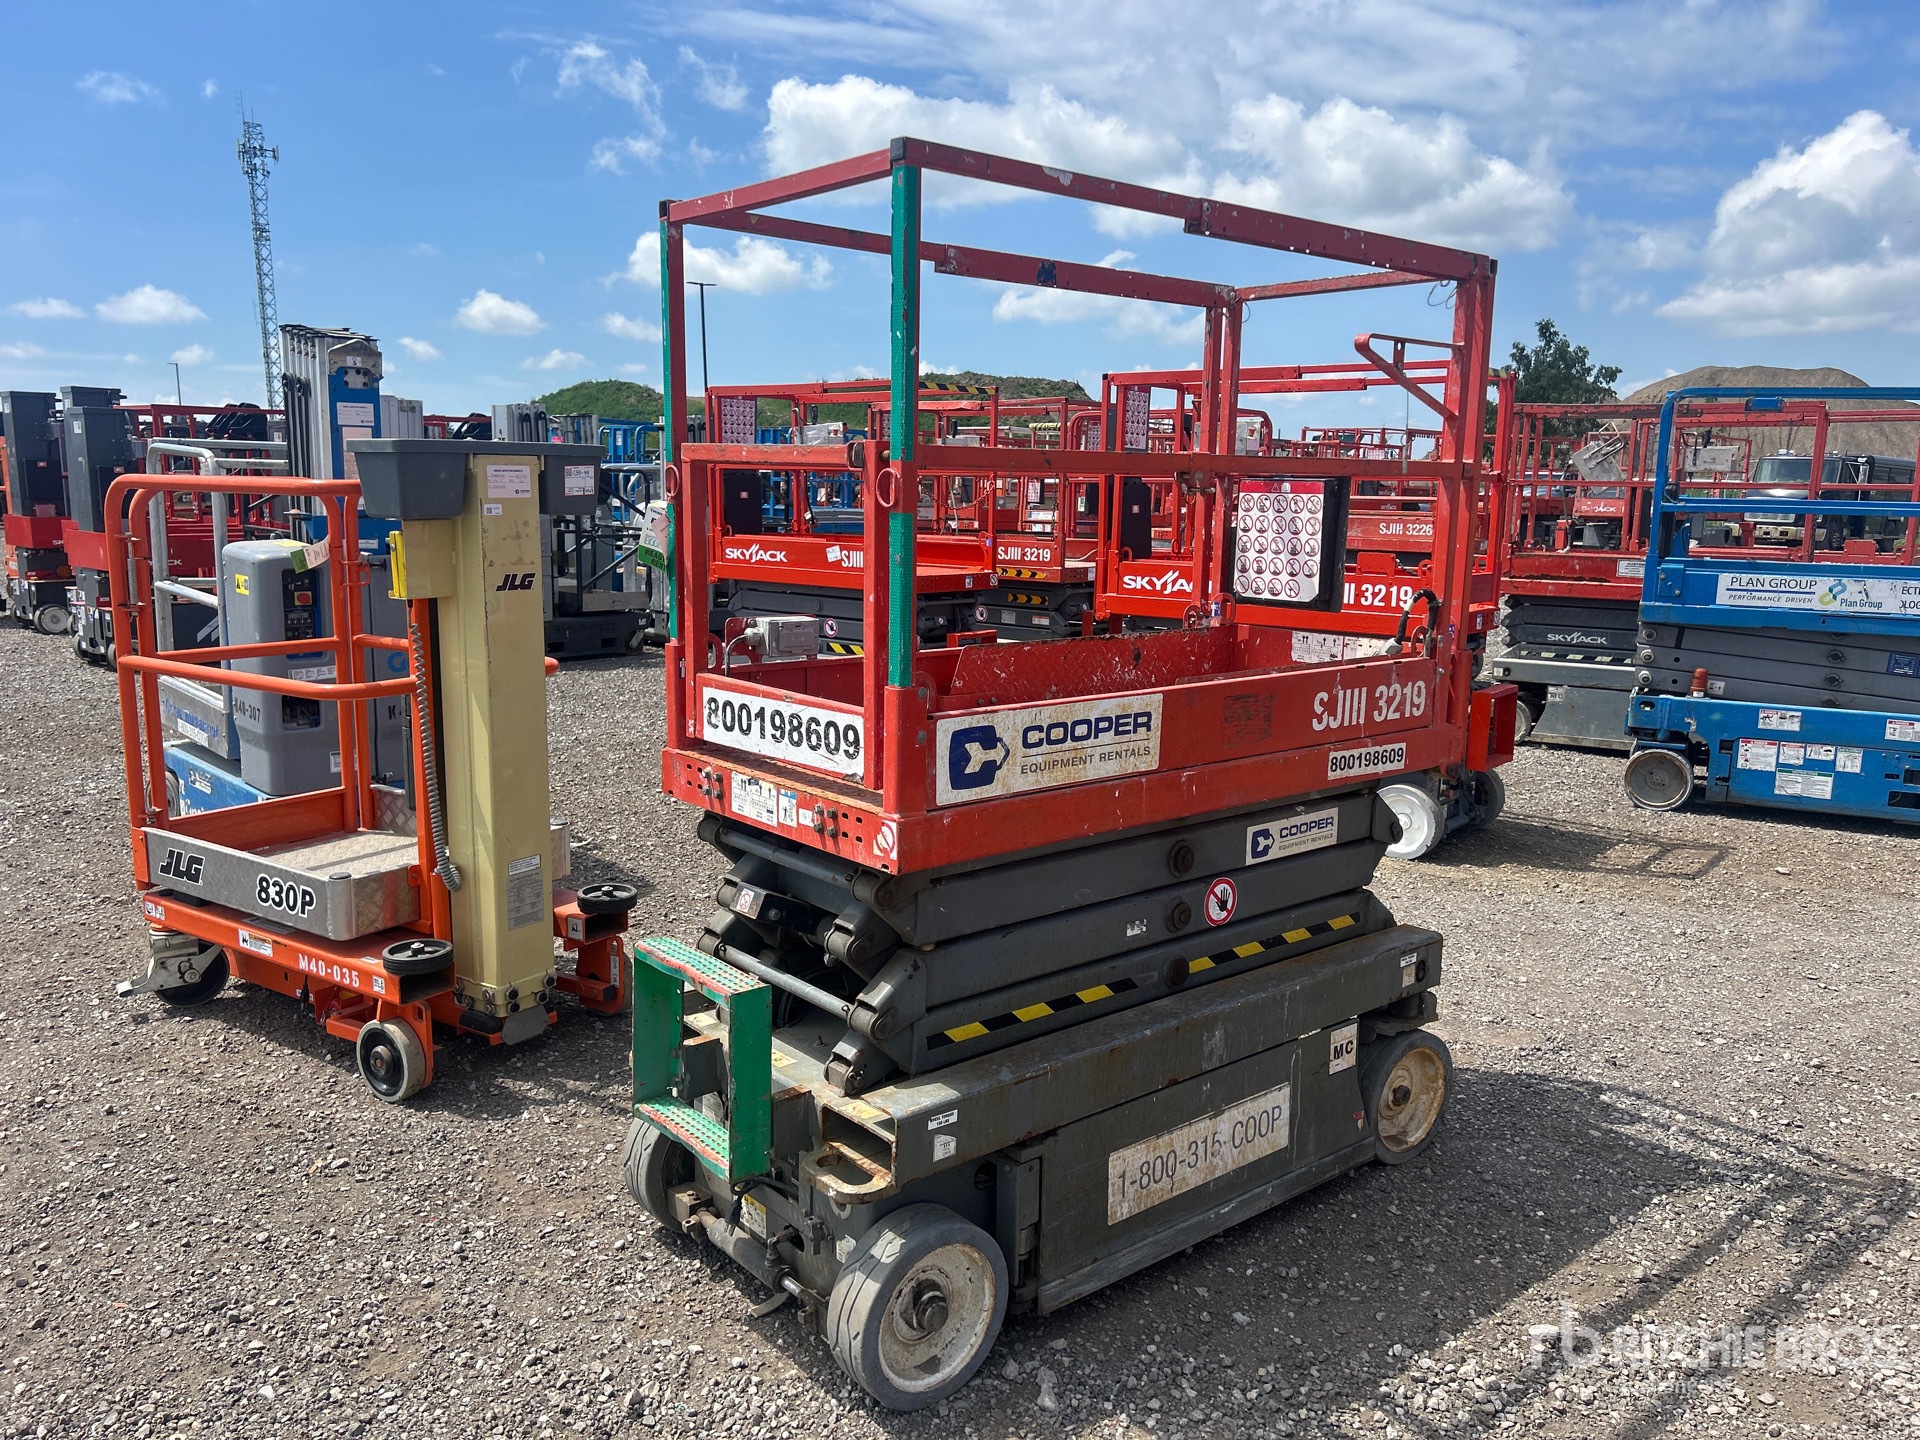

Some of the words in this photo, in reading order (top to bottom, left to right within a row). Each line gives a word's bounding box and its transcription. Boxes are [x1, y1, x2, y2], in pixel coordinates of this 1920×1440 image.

[1405, 523, 1434, 536] 3226
[725, 543, 788, 563] SKYJACK
[1024, 547, 1051, 562] 3219
[496, 572, 536, 592] JLG
[1730, 576, 1767, 590] PLAN
[1768, 578, 1818, 591] GROUP
[1360, 583, 1414, 609] 3219
[1728, 594, 1782, 603] PERFORMANCE
[1785, 596, 1813, 604] DRIVEN
[1840, 597, 1858, 608] Plan
[1859, 598, 1883, 611] Group
[1546, 631, 1608, 645] SKYJACK
[1312, 687, 1368, 731] SJIII
[1373, 680, 1427, 723] 3219
[706, 696, 861, 760] 800198609
[1022, 711, 1153, 750] COOPER
[1020, 753, 1095, 775] EQUIPMENT
[1099, 745, 1152, 763] RENTALS
[1329, 746, 1405, 773] 800198609
[1279, 816, 1335, 839] COOPER
[1278, 838, 1310, 851] EQUIPMENT
[1310, 832, 1334, 843] RENTALS
[159, 848, 206, 886] JLG
[256, 873, 317, 919] 830P
[298, 952, 361, 988] M40-035
[1333, 1039, 1354, 1060] MC
